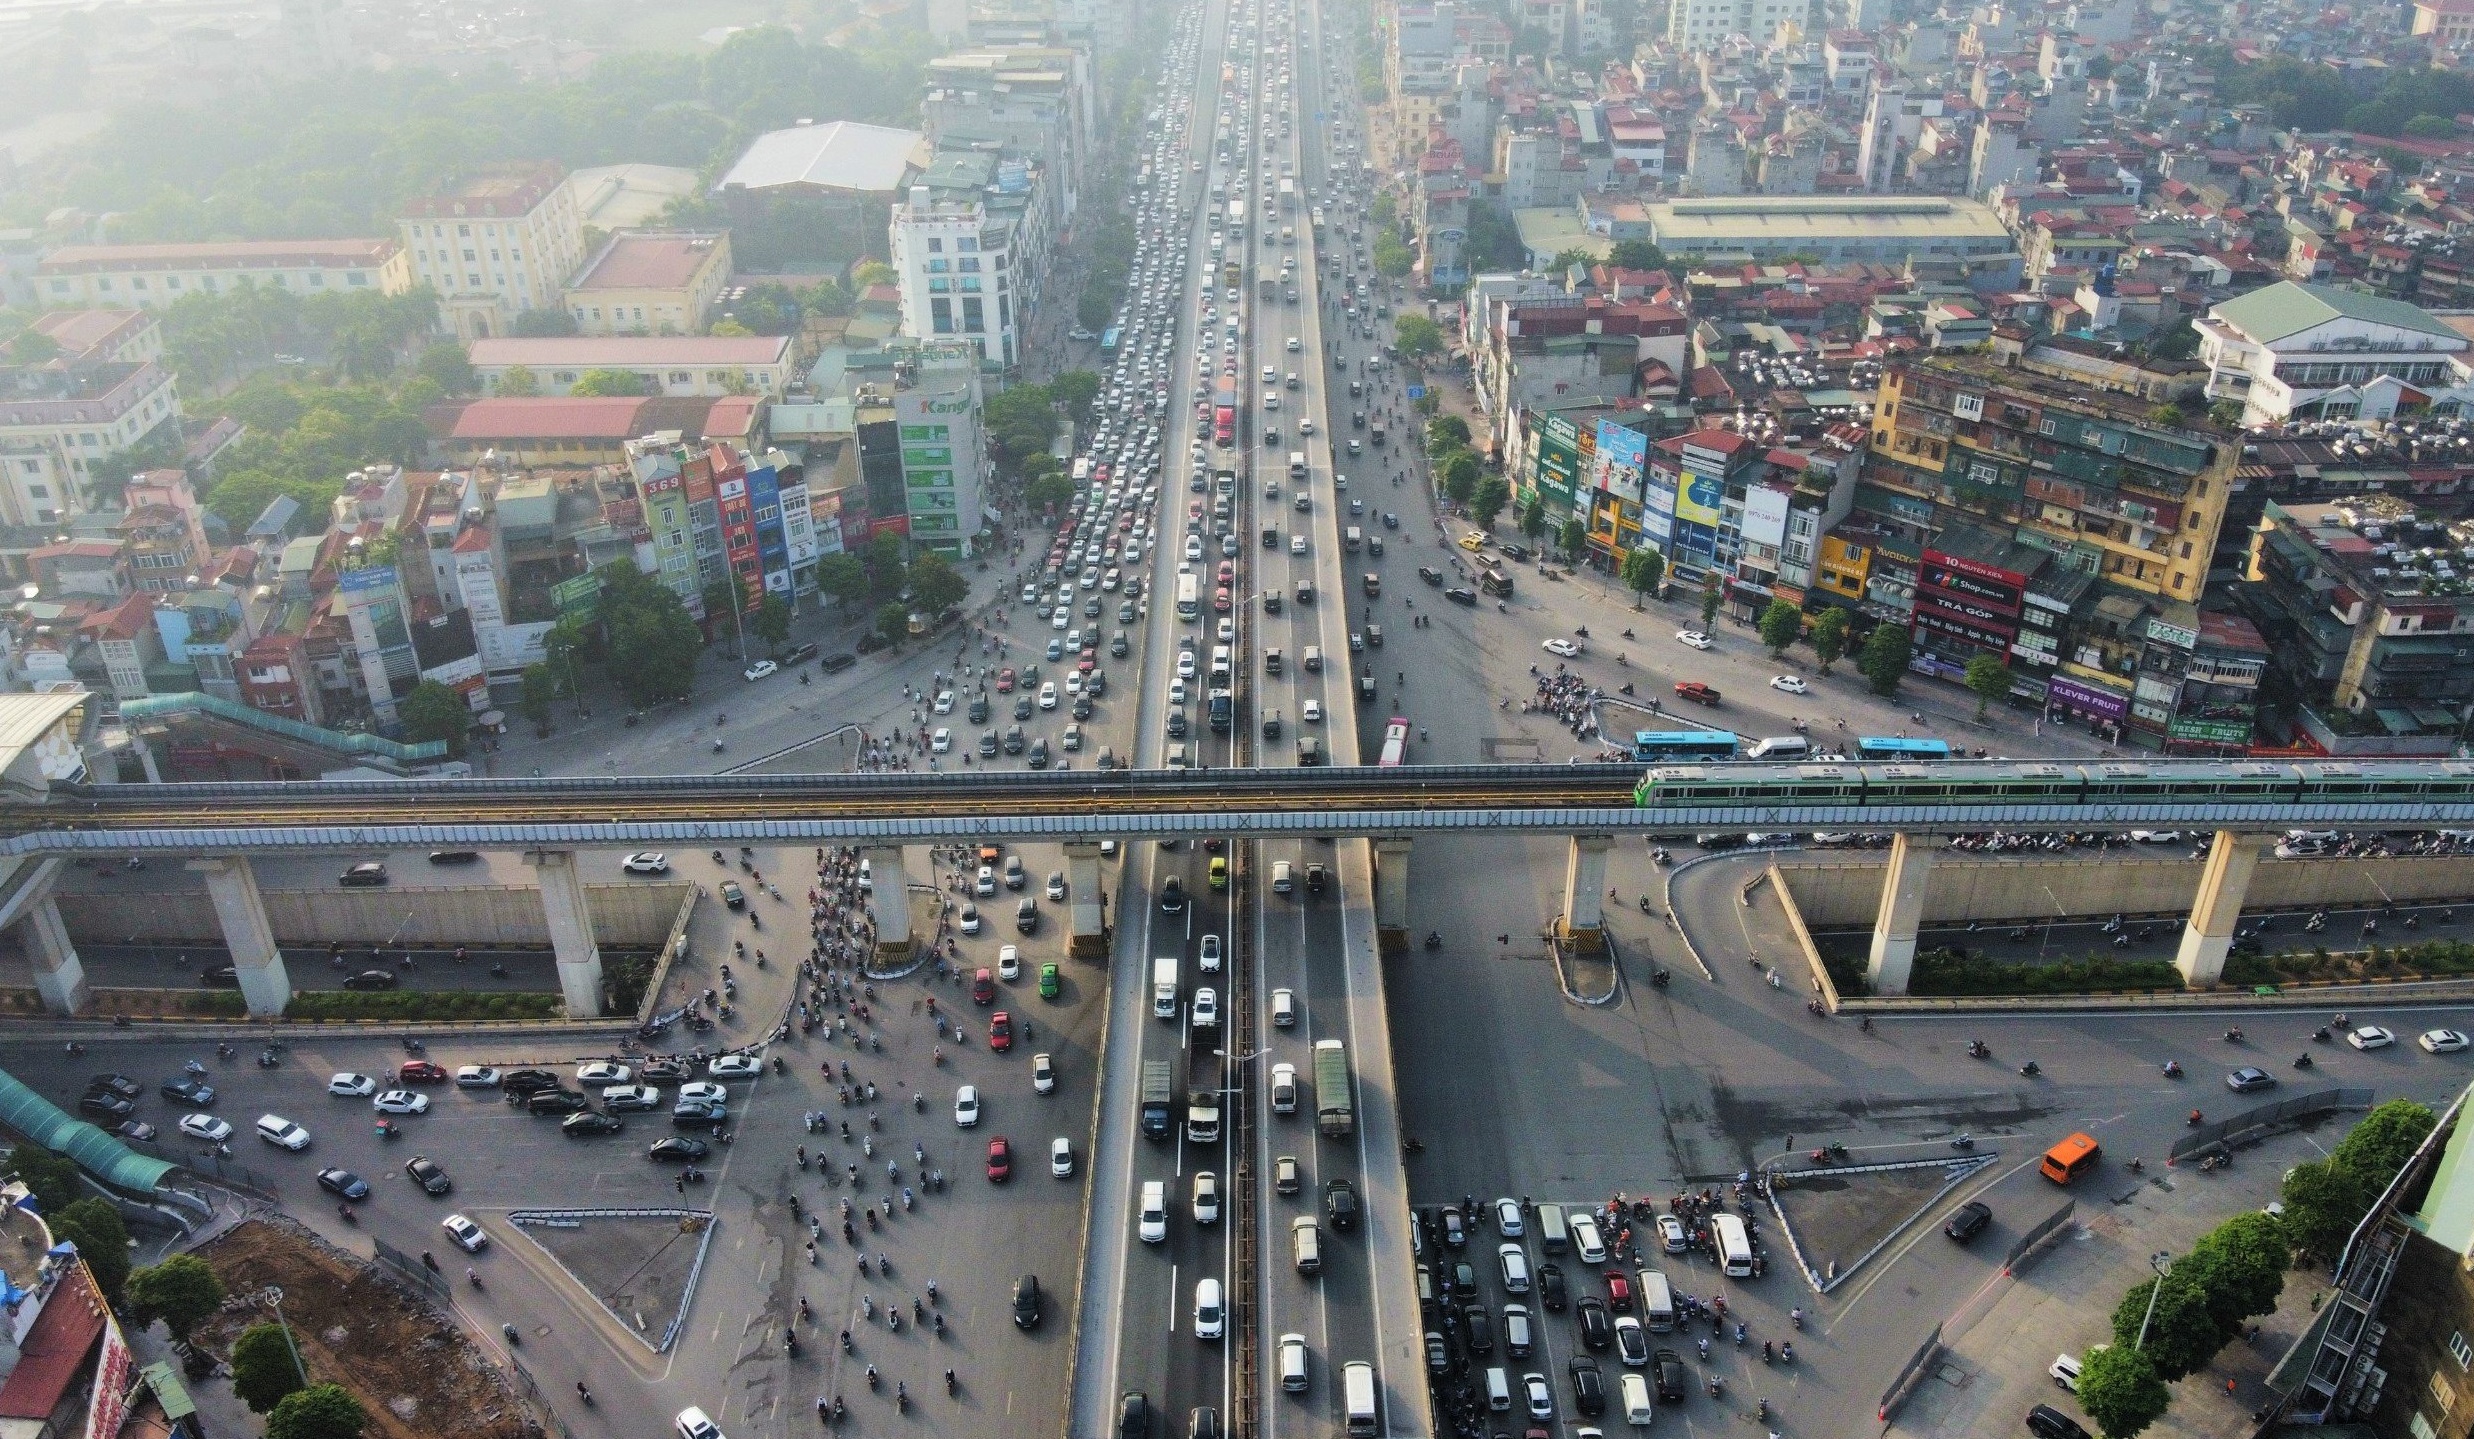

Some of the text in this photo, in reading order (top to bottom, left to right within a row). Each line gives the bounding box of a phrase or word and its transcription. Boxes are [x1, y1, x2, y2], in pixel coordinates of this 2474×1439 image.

[1548, 417, 1575, 439] Kagawa
[1540, 472, 1569, 494] Kagawa
[1945, 556, 1959, 567] 10
[2148, 622, 2192, 644] FASTER
[2053, 685, 2120, 711] KLEVER FRUIT
[2172, 724, 2202, 734] FRESH
[2211, 727, 2245, 737] FRUITS
